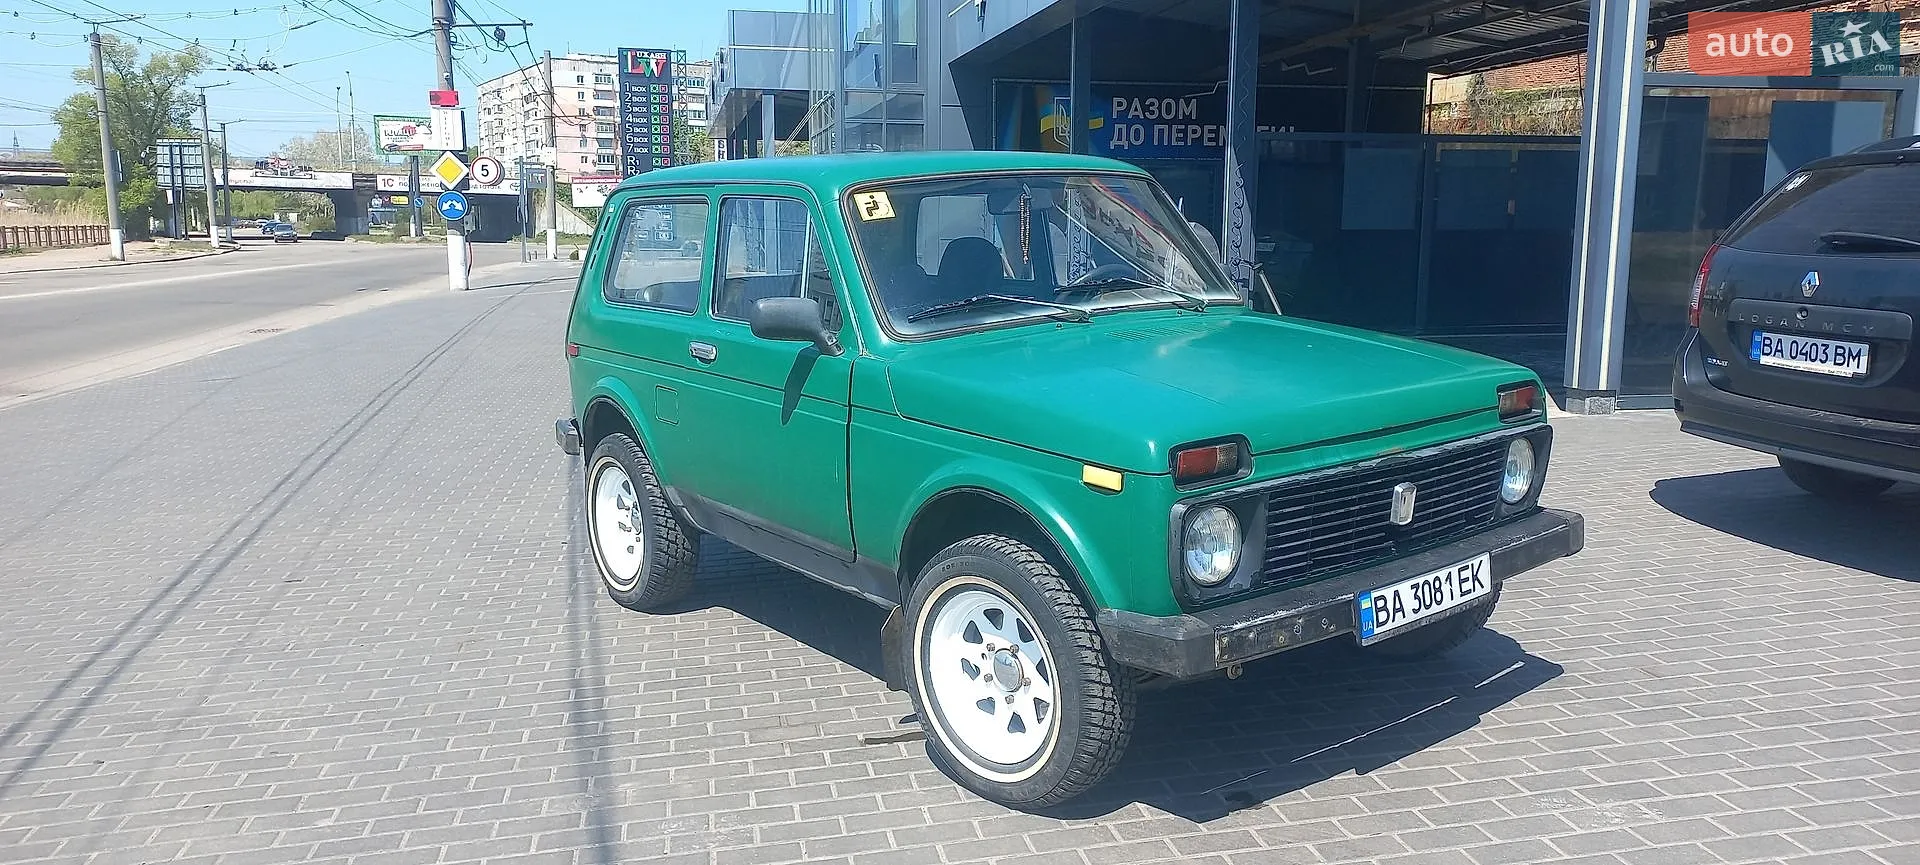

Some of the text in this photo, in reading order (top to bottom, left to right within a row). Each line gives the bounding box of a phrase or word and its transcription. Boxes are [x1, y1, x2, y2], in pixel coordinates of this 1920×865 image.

[1112, 97, 1197, 120] РАЗОМ
[1110, 123, 1145, 150] ДО
[480, 164, 490, 178] 5
[1738, 313, 1806, 328] LOGAN
[1762, 336, 1784, 358] BA
[1789, 342, 1830, 364] 0403
[1833, 345, 1863, 370] BM
[1374, 590, 1406, 629] BA
[1410, 571, 1455, 615] 3081
[1458, 560, 1485, 597] EK
[1363, 622, 1374, 632] UA
